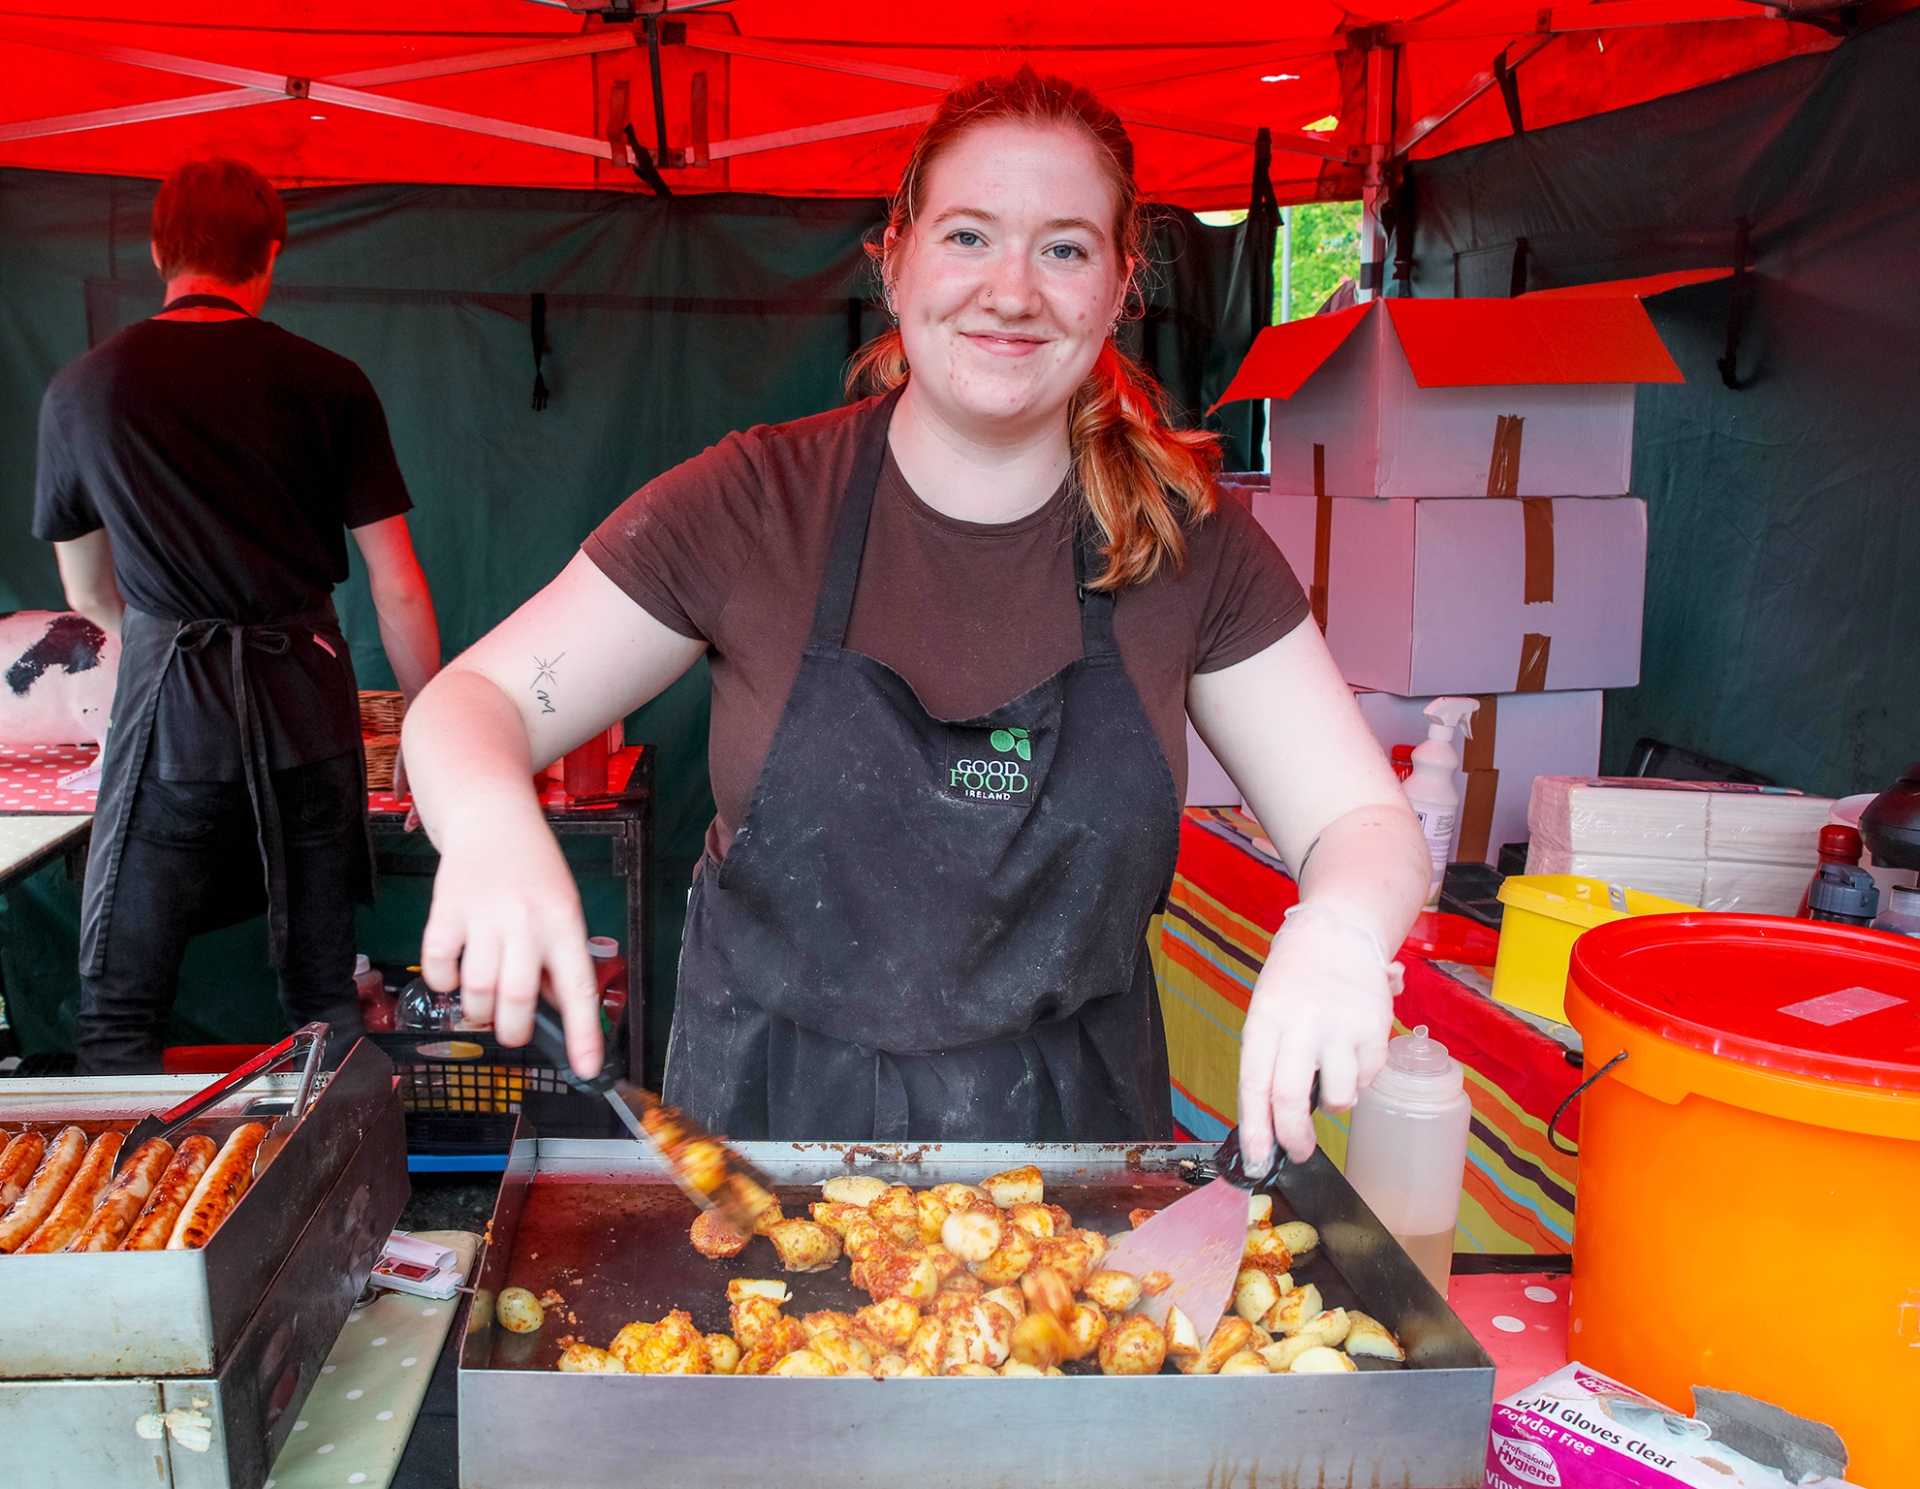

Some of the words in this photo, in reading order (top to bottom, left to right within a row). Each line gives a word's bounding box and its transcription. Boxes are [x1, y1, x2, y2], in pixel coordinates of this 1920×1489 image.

[949, 768, 1029, 793] FOOD
[956, 759, 1020, 777] GOOD
[965, 789, 1011, 801] IRELAND
[1498, 1408, 1558, 1440] Powder
[1559, 1434, 1595, 1457] Free
[1561, 1408, 1622, 1445] Gloves
[1626, 1440, 1677, 1469] Clear
[1499, 1446, 1557, 1485] Hygiene
[1502, 1439, 1554, 1470] Professional
